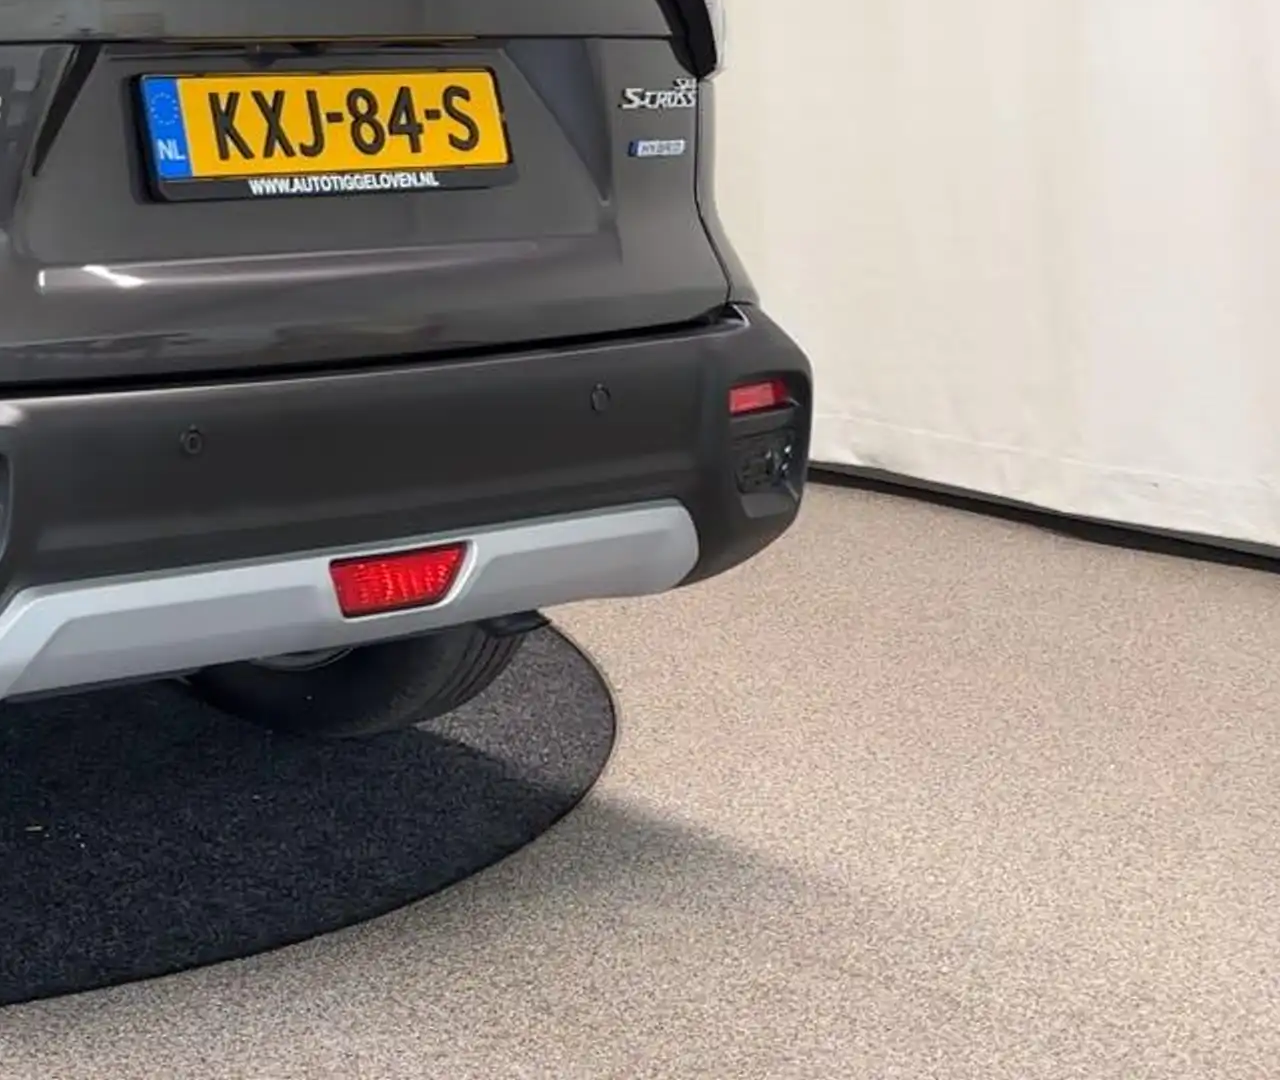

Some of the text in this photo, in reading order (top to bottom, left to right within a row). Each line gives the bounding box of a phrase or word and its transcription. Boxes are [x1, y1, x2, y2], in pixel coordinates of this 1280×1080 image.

[208, 85, 480, 161] KXJ-84-S
[157, 138, 186, 161] NL
[248, 172, 440, 196] WWW.AUTOTIGGELOVEN.NL
